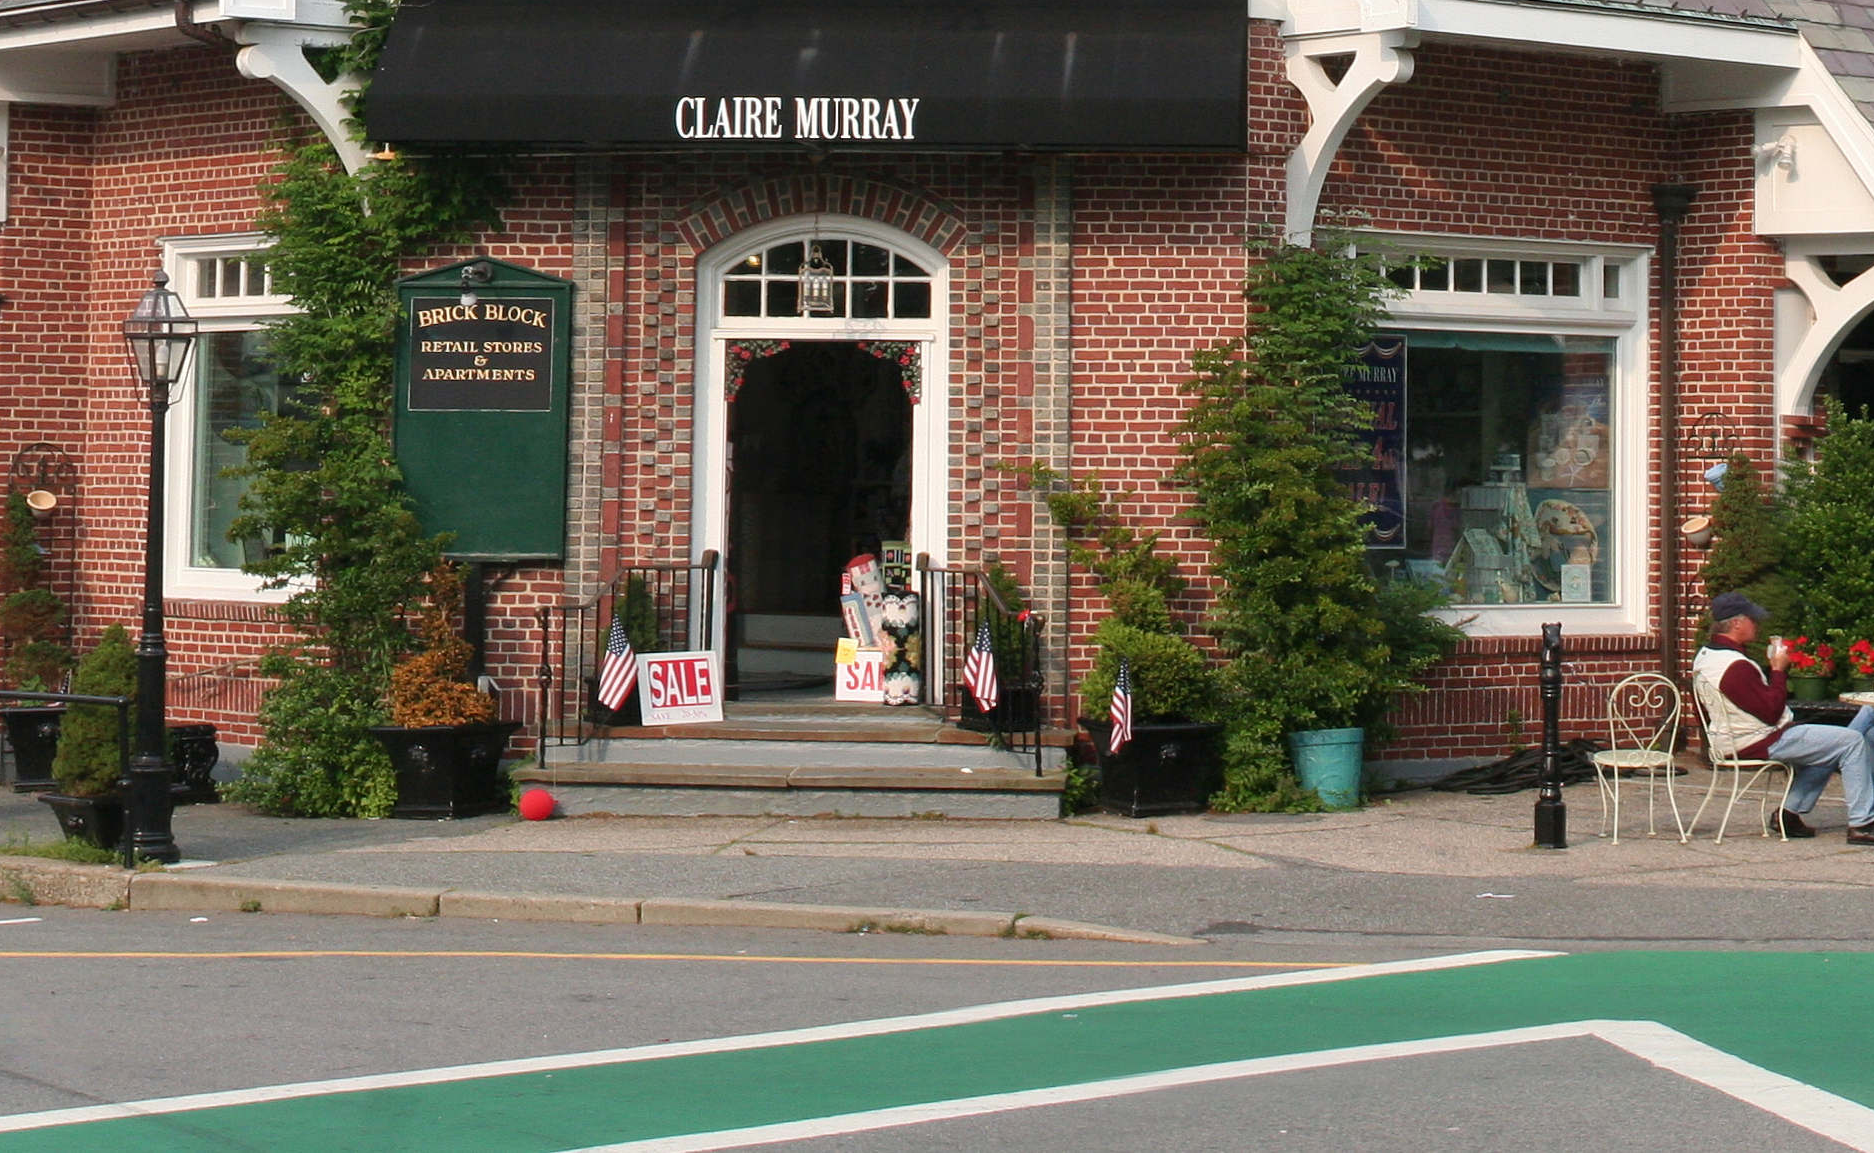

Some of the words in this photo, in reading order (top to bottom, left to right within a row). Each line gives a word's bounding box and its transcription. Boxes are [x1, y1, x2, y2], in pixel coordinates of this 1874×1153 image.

[675, 96, 782, 139] CLAIRE
[794, 97, 919, 140] MURRAY
[417, 304, 478, 328] BRICK
[484, 304, 547, 329] BLOCK
[421, 341, 479, 353] RETAIL
[483, 341, 543, 353] STORES
[474, 355, 489, 367] &
[422, 368, 536, 381] APARTMENTS
[649, 660, 712, 706] SALE
